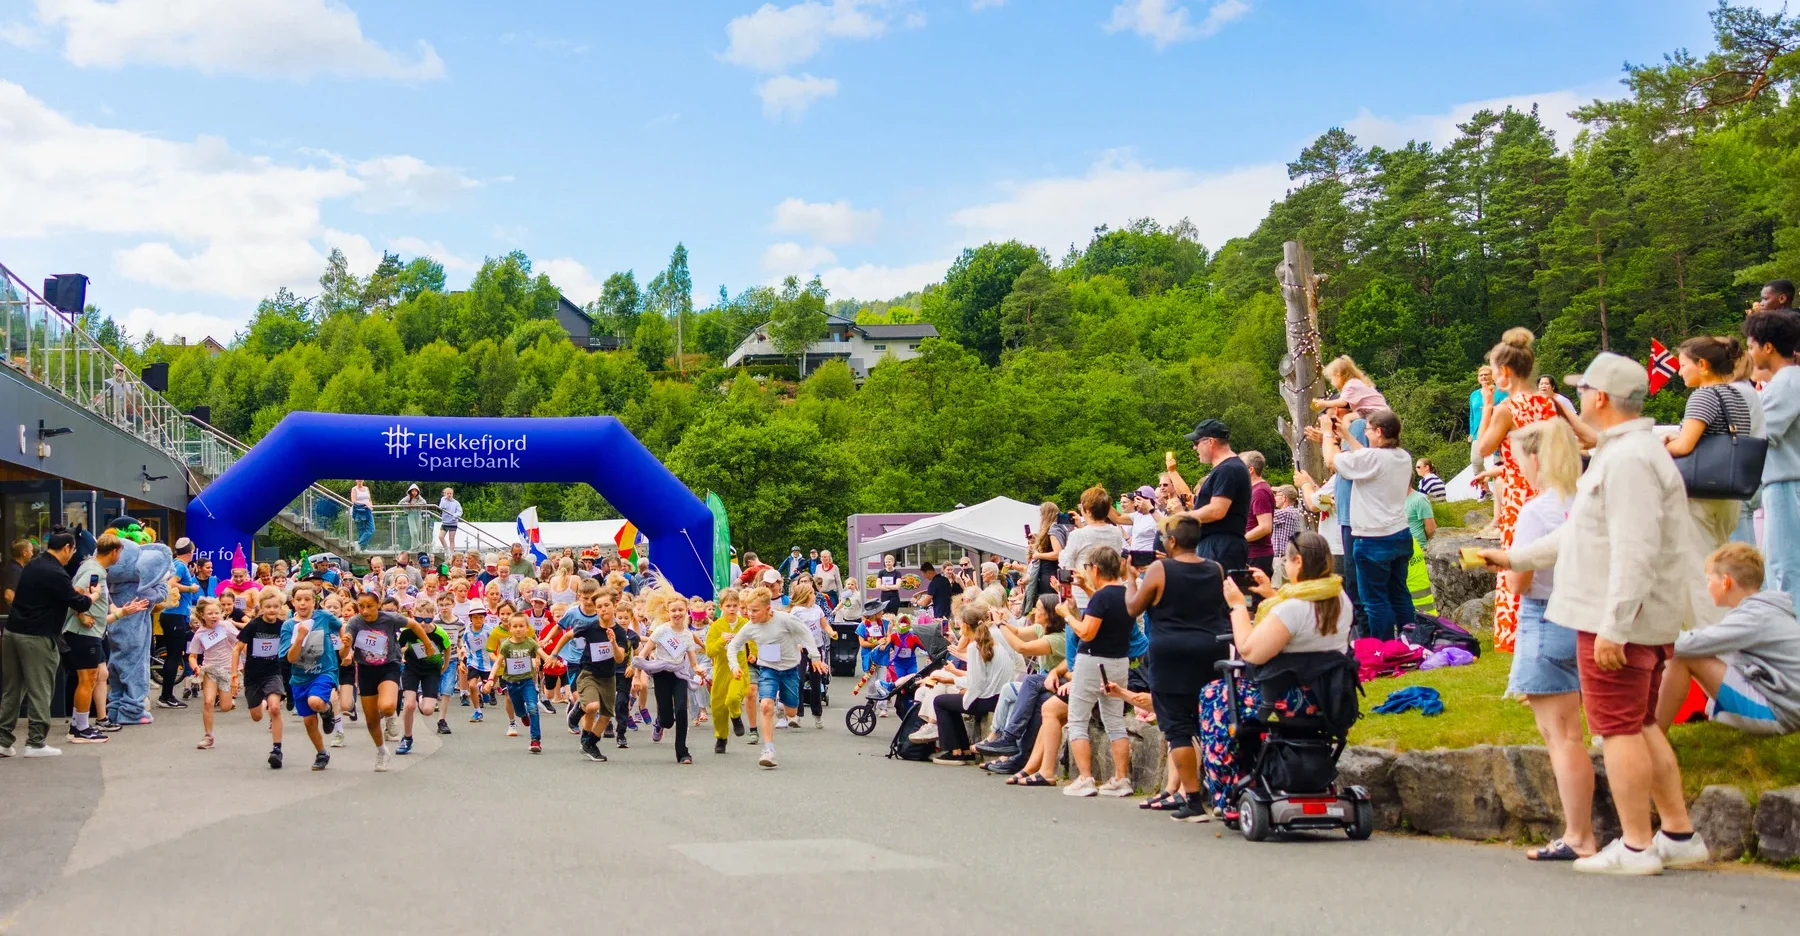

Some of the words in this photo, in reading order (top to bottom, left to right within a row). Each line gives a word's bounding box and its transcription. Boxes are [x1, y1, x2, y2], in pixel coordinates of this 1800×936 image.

[418, 433, 526, 455] Flekkefjord
[418, 452, 520, 471] Sparebank
[219, 546, 234, 560] fo
[365, 638, 376, 646] 113
[667, 638, 678, 650] 284
